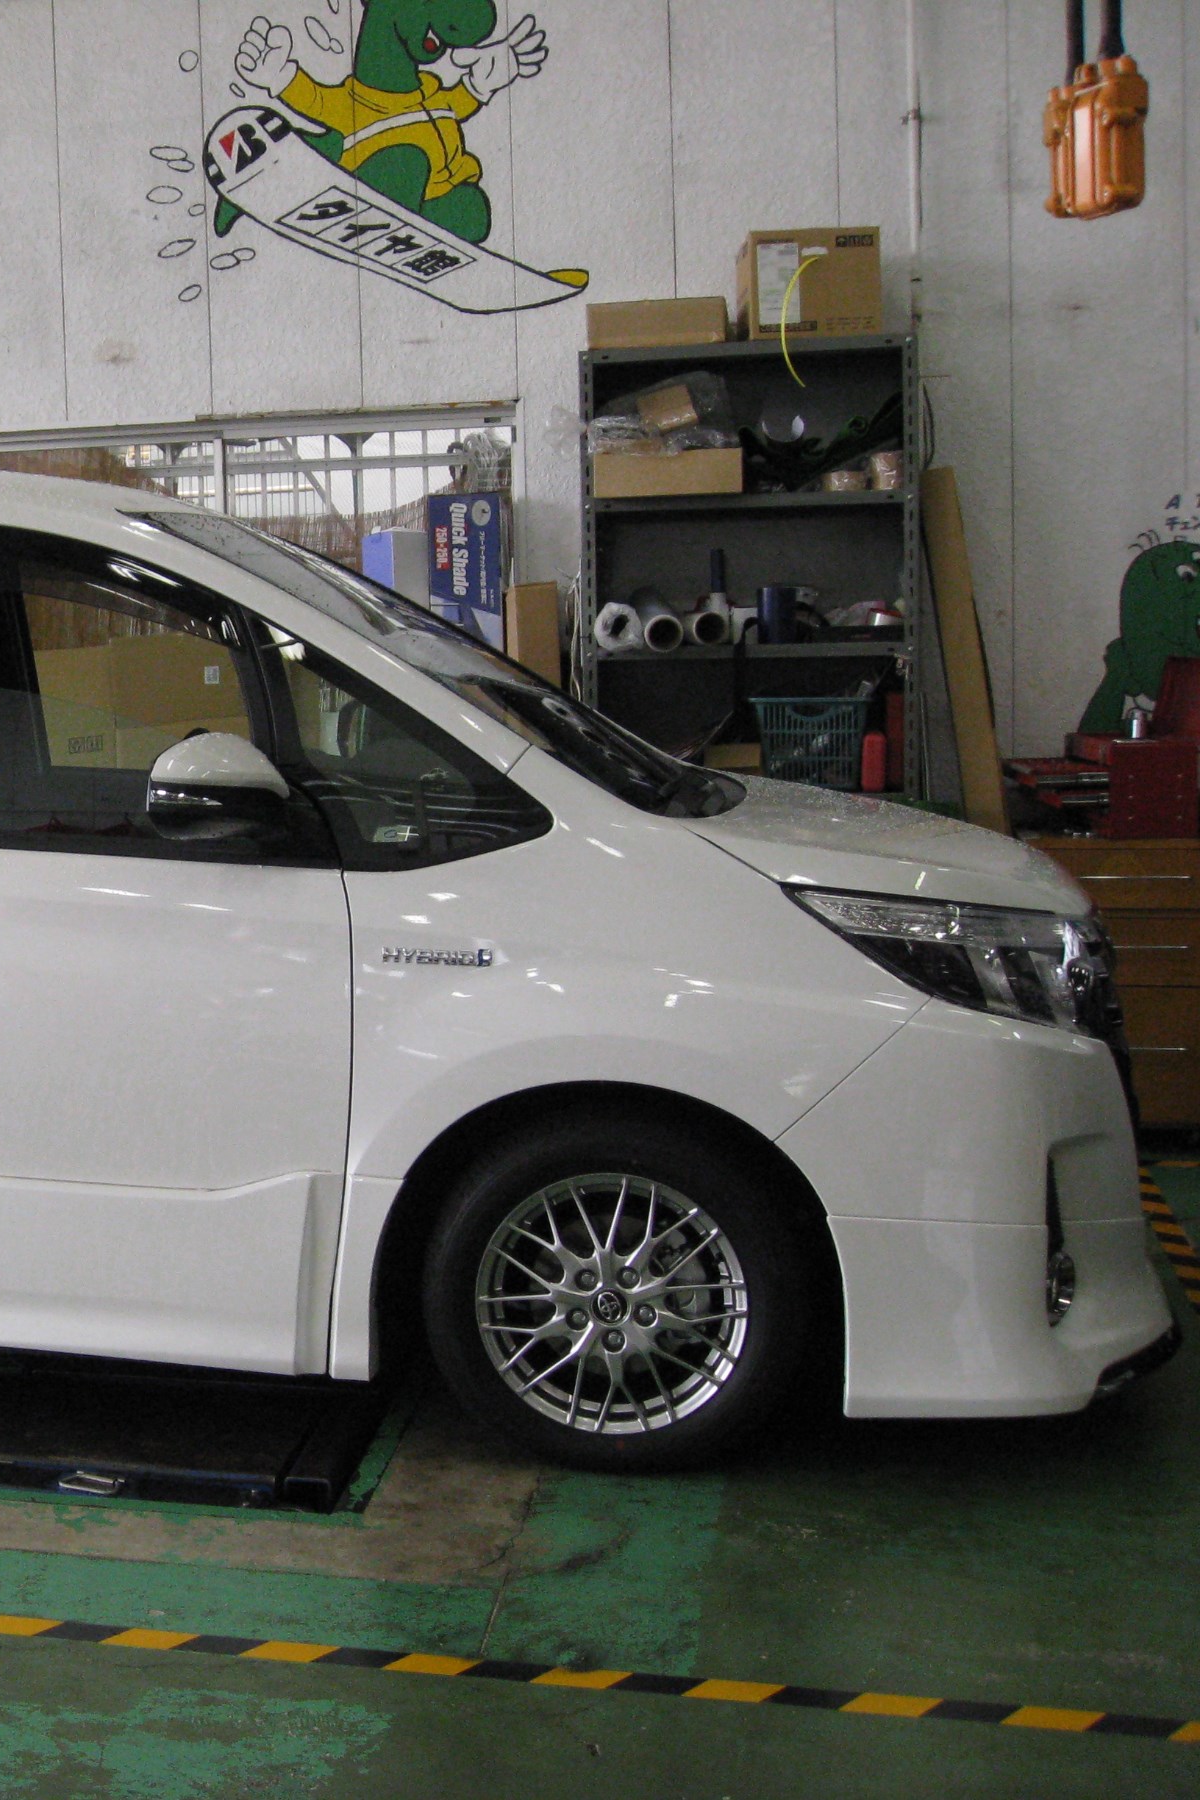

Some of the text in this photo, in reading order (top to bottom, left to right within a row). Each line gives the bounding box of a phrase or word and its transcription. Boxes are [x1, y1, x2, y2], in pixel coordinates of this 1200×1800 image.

[296, 200, 461, 276] タイヤ館
[449, 502, 469, 595] Quick Shade
[381, 946, 477, 966] HYBRID
